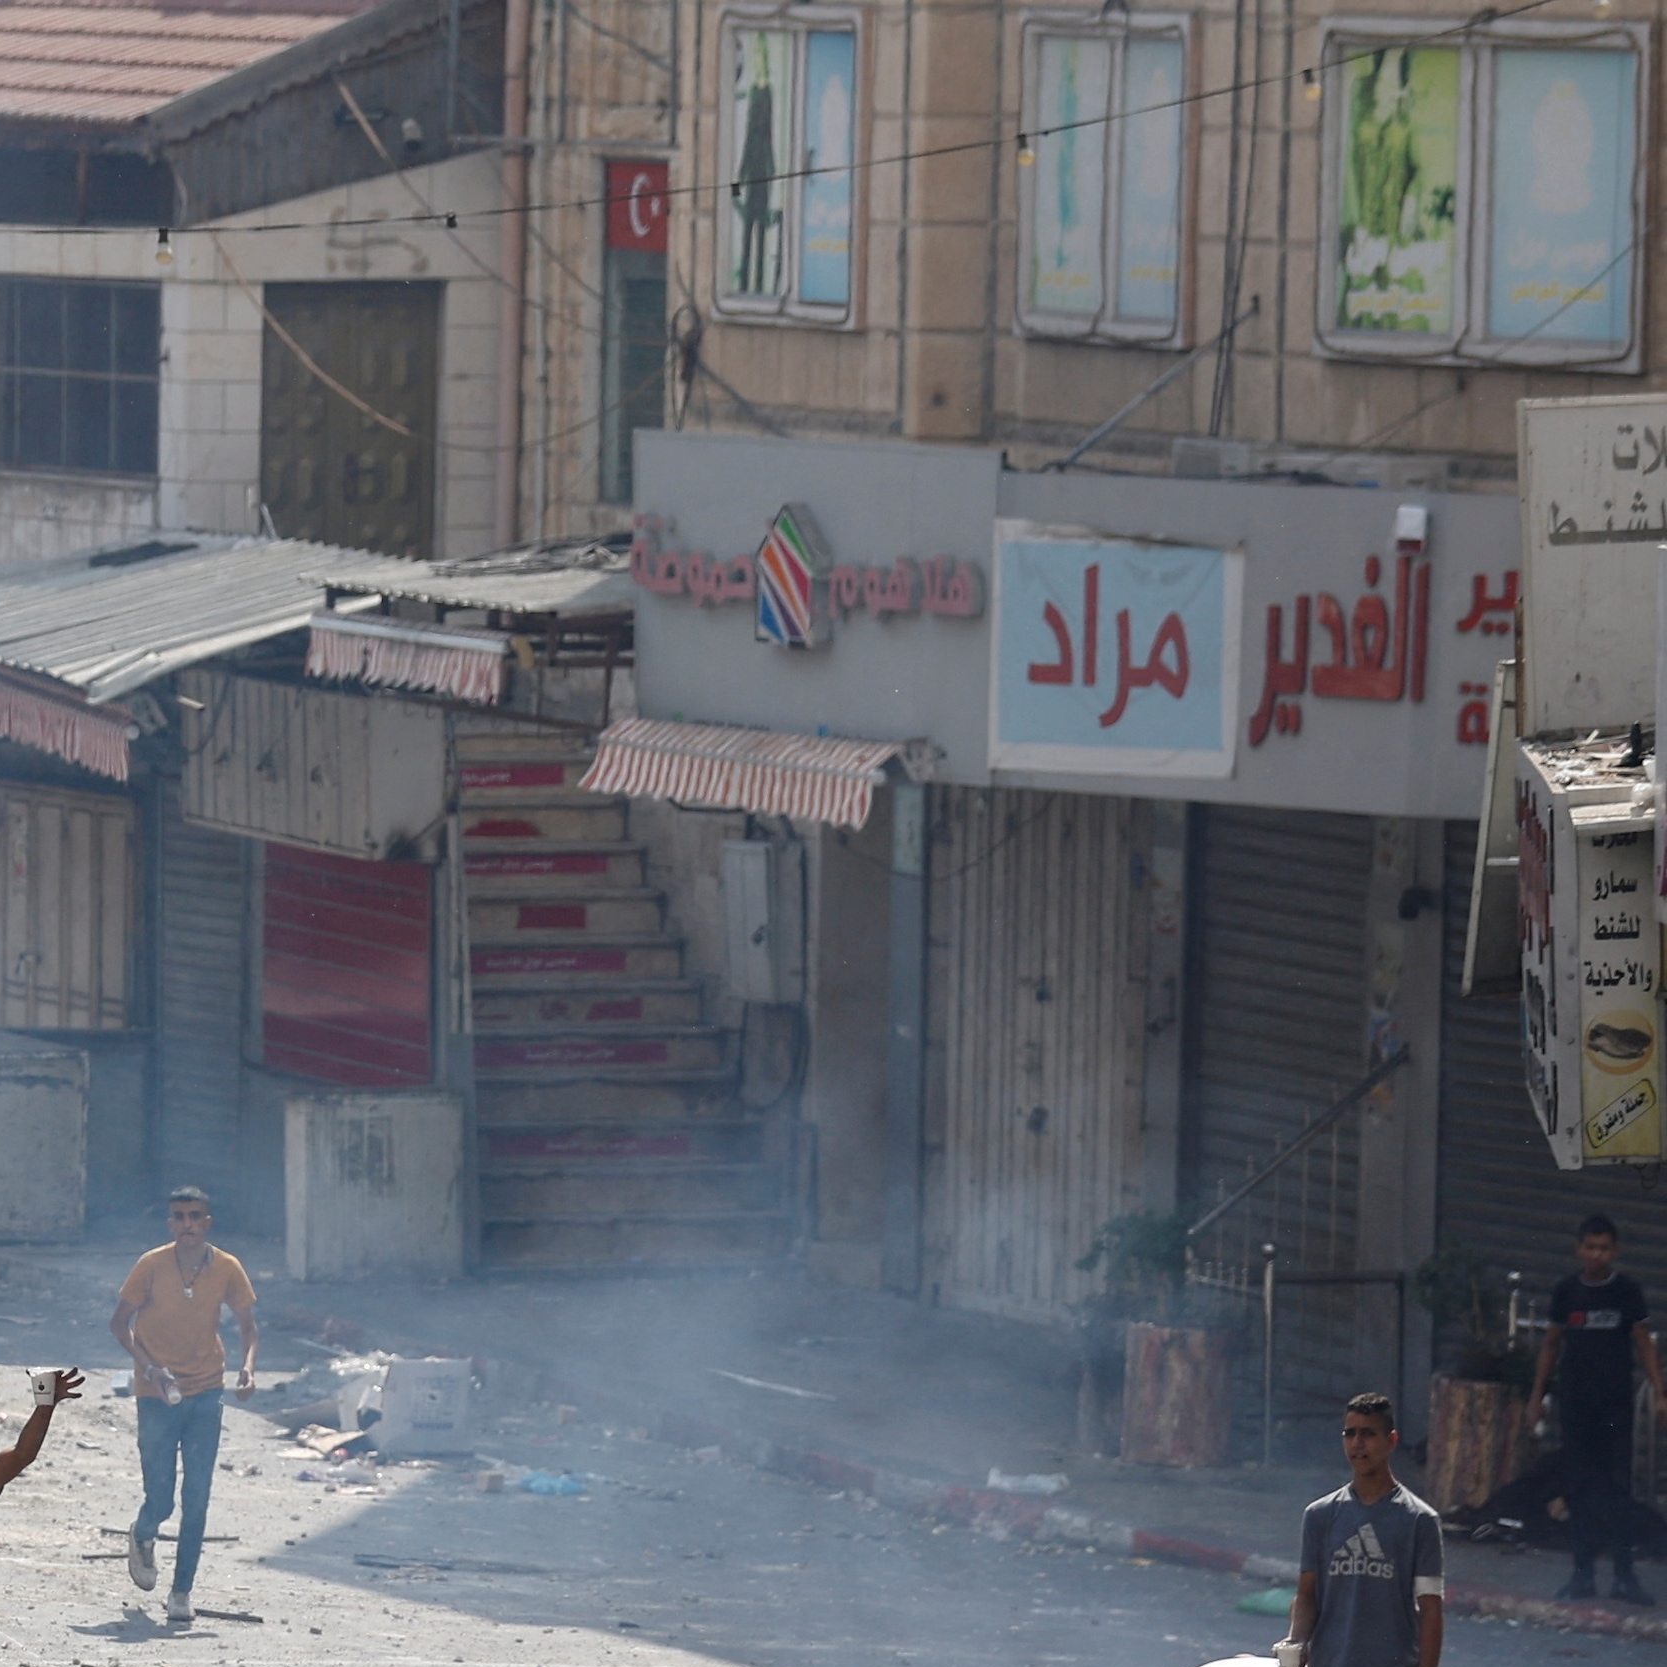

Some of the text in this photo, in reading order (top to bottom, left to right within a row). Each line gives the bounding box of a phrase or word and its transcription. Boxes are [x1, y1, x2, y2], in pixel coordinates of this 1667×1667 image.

[829, 555, 911, 619] هوم
[1028, 563, 1190, 727] مراد
[1248, 555, 1430, 748] الغدير
[1593, 871, 1638, 900] سمارو
[1594, 912, 1641, 940] للشنط
[1584, 959, 1653, 996] والأحذية
[1328, 1556, 1395, 1579] adidas
